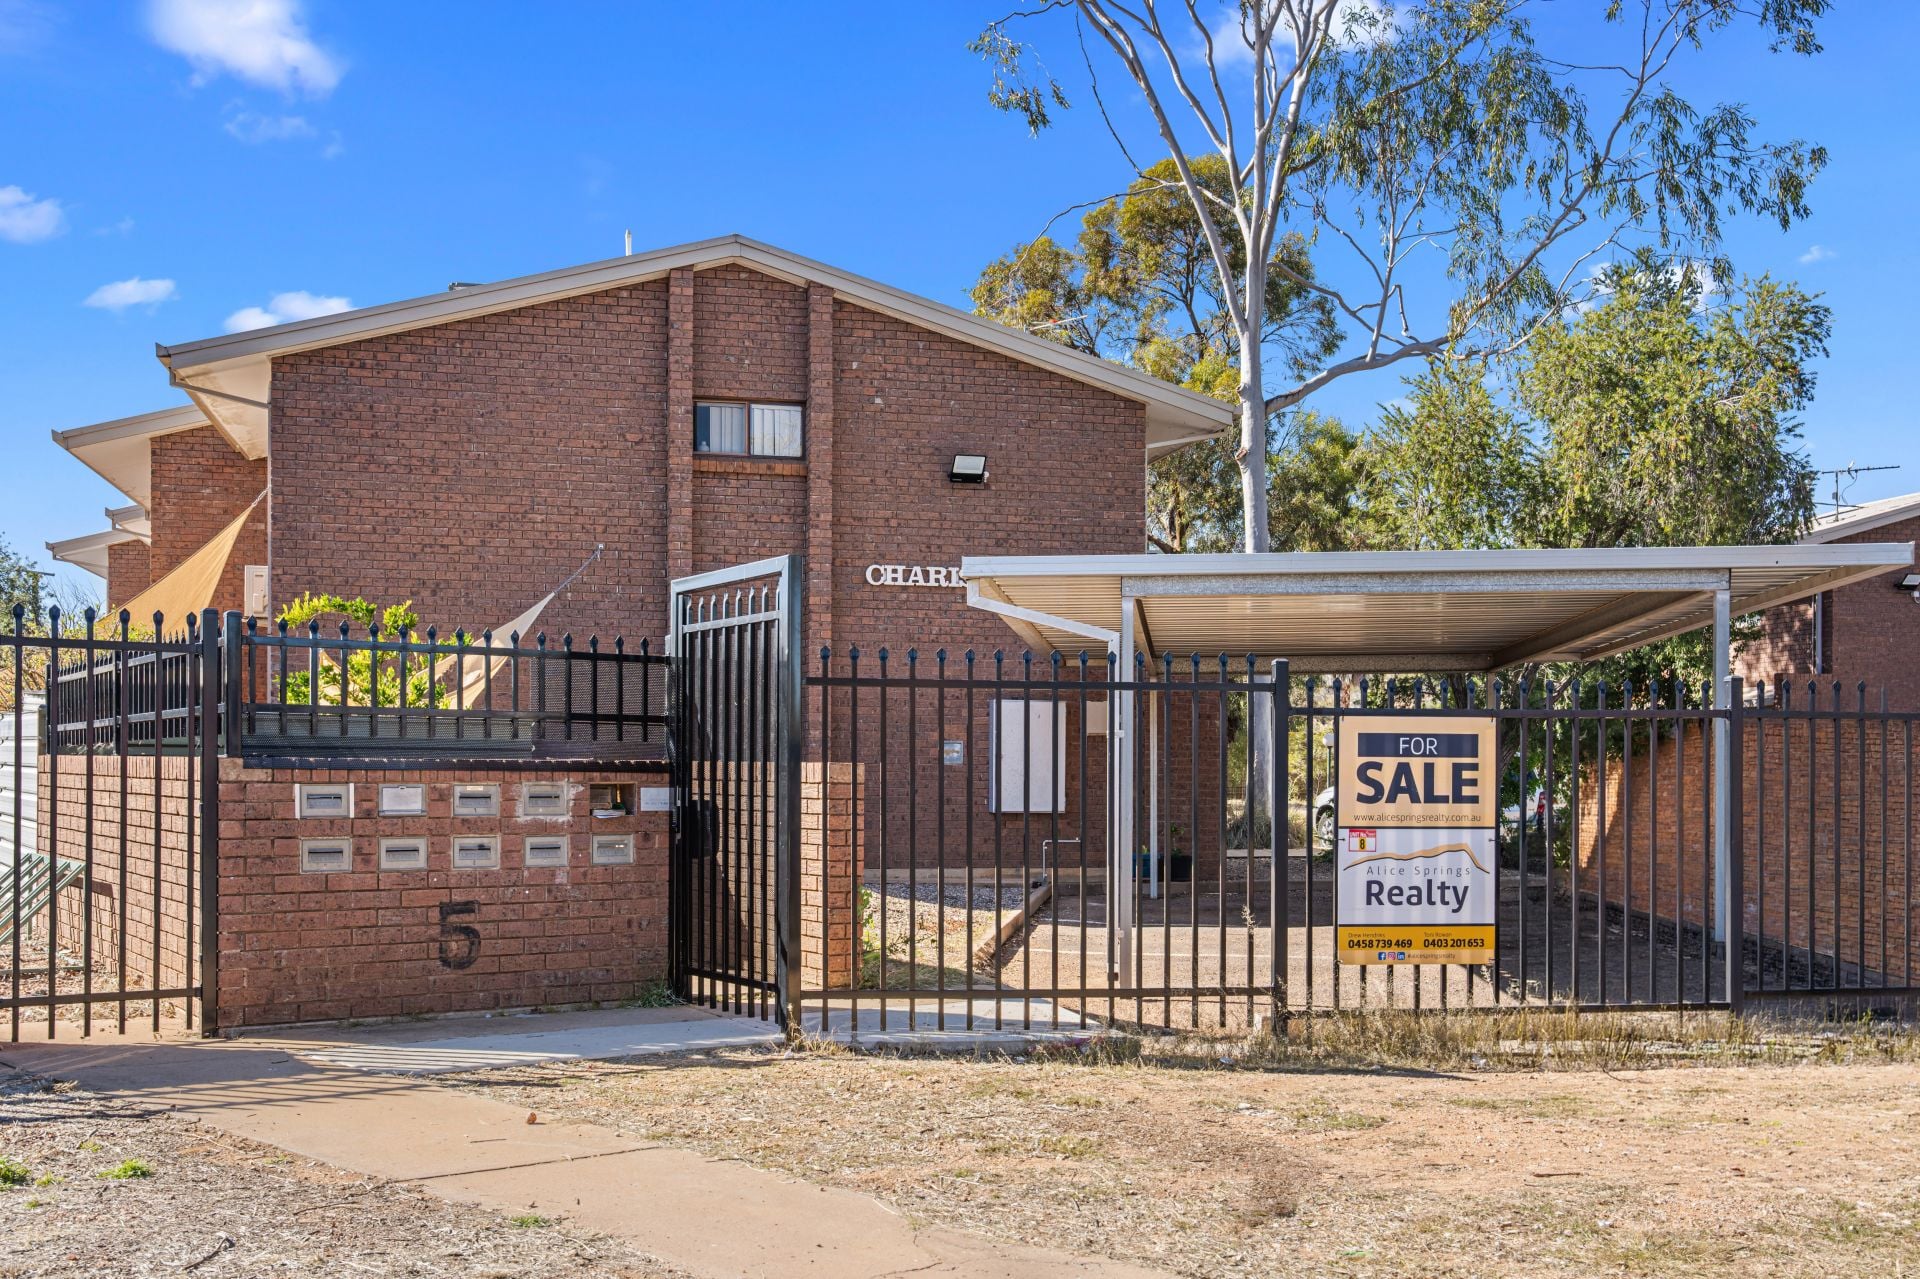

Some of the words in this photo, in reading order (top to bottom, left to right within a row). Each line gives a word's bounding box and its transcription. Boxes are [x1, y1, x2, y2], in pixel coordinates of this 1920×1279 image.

[1399, 737, 1438, 755] FOR
[1356, 761, 1479, 804] SALE
[1353, 812, 1481, 824] www.alicespringsrealty.com.au
[1359, 838, 1366, 850] 8
[1367, 866, 1405, 876] Alice
[1414, 866, 1471, 877] Springs
[1365, 879, 1469, 913] Realty
[439, 899, 481, 970] 5
[1348, 939, 1374, 948] 0458
[1375, 939, 1393, 948] 739
[1394, 939, 1412, 948] 469
[1423, 938, 1449, 948] 0403
[1450, 938, 1466, 948] 201
[1467, 938, 1485, 948] 653
